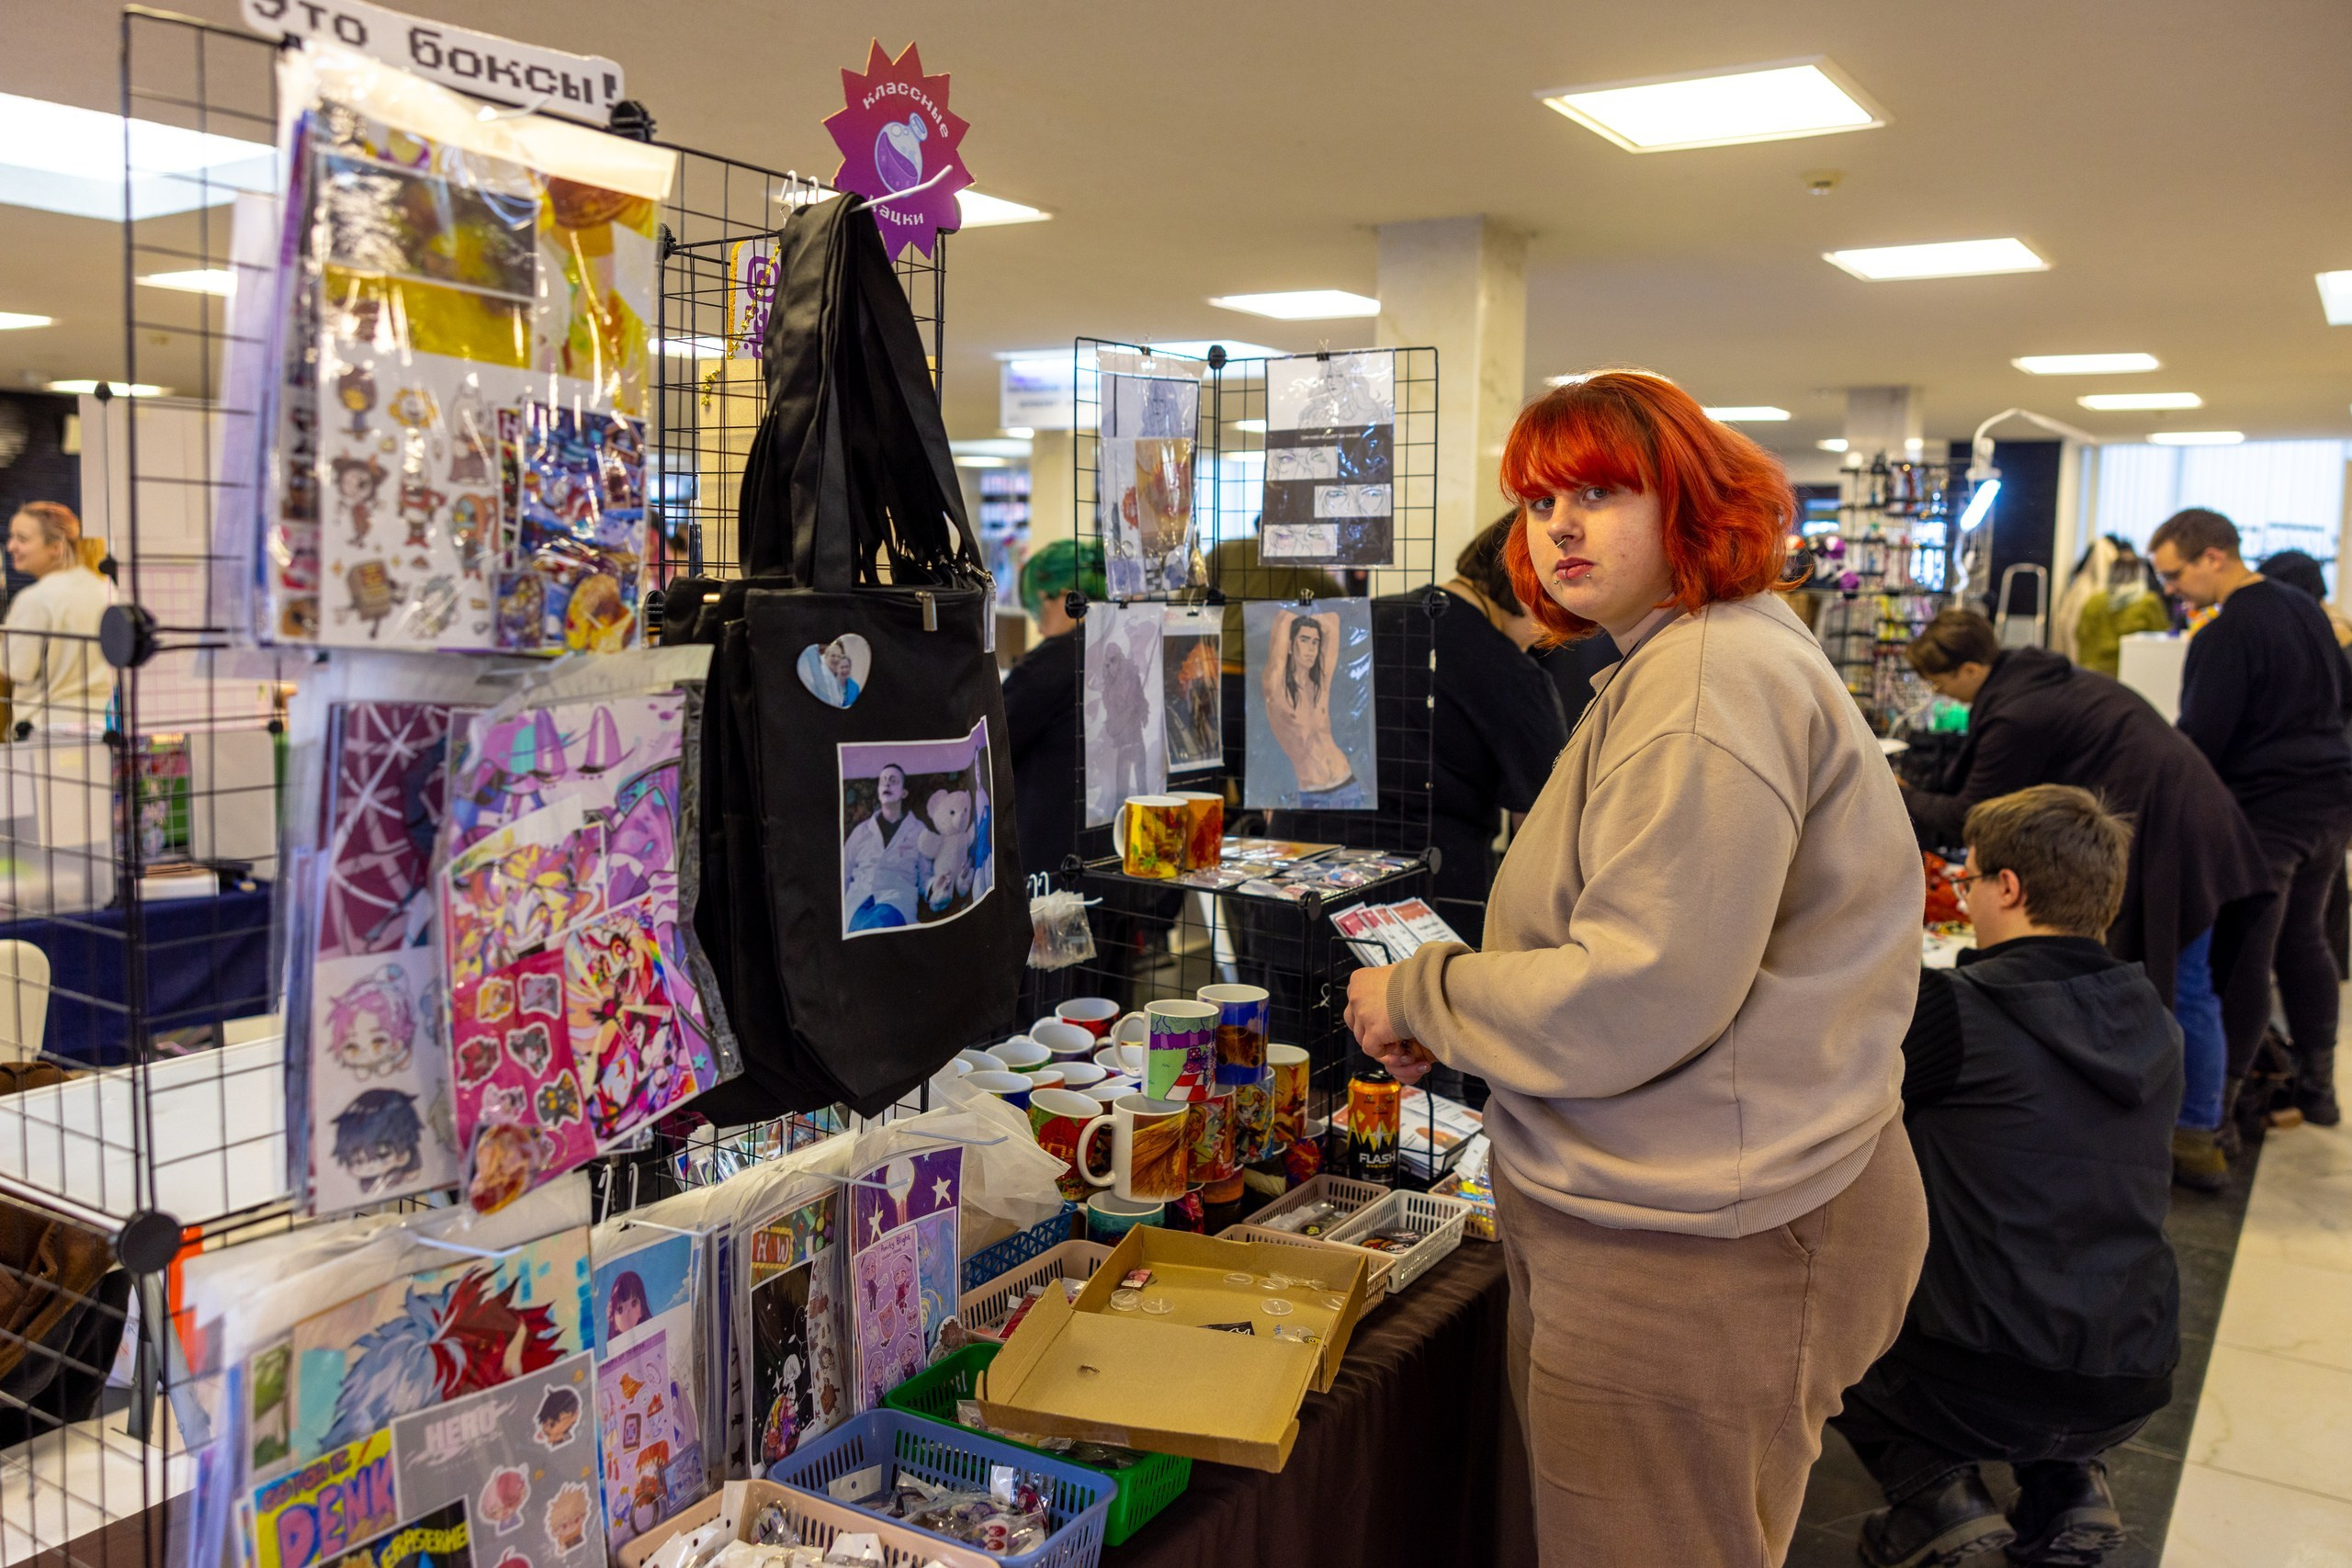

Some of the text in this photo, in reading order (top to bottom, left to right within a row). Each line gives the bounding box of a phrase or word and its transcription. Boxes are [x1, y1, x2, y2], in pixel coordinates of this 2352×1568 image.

[409, 28, 618, 110] боксы!
[862, 82, 949, 139] классные
[1359, 1150, 1396, 1165] FLASH
[424, 1399, 499, 1453] HERO
